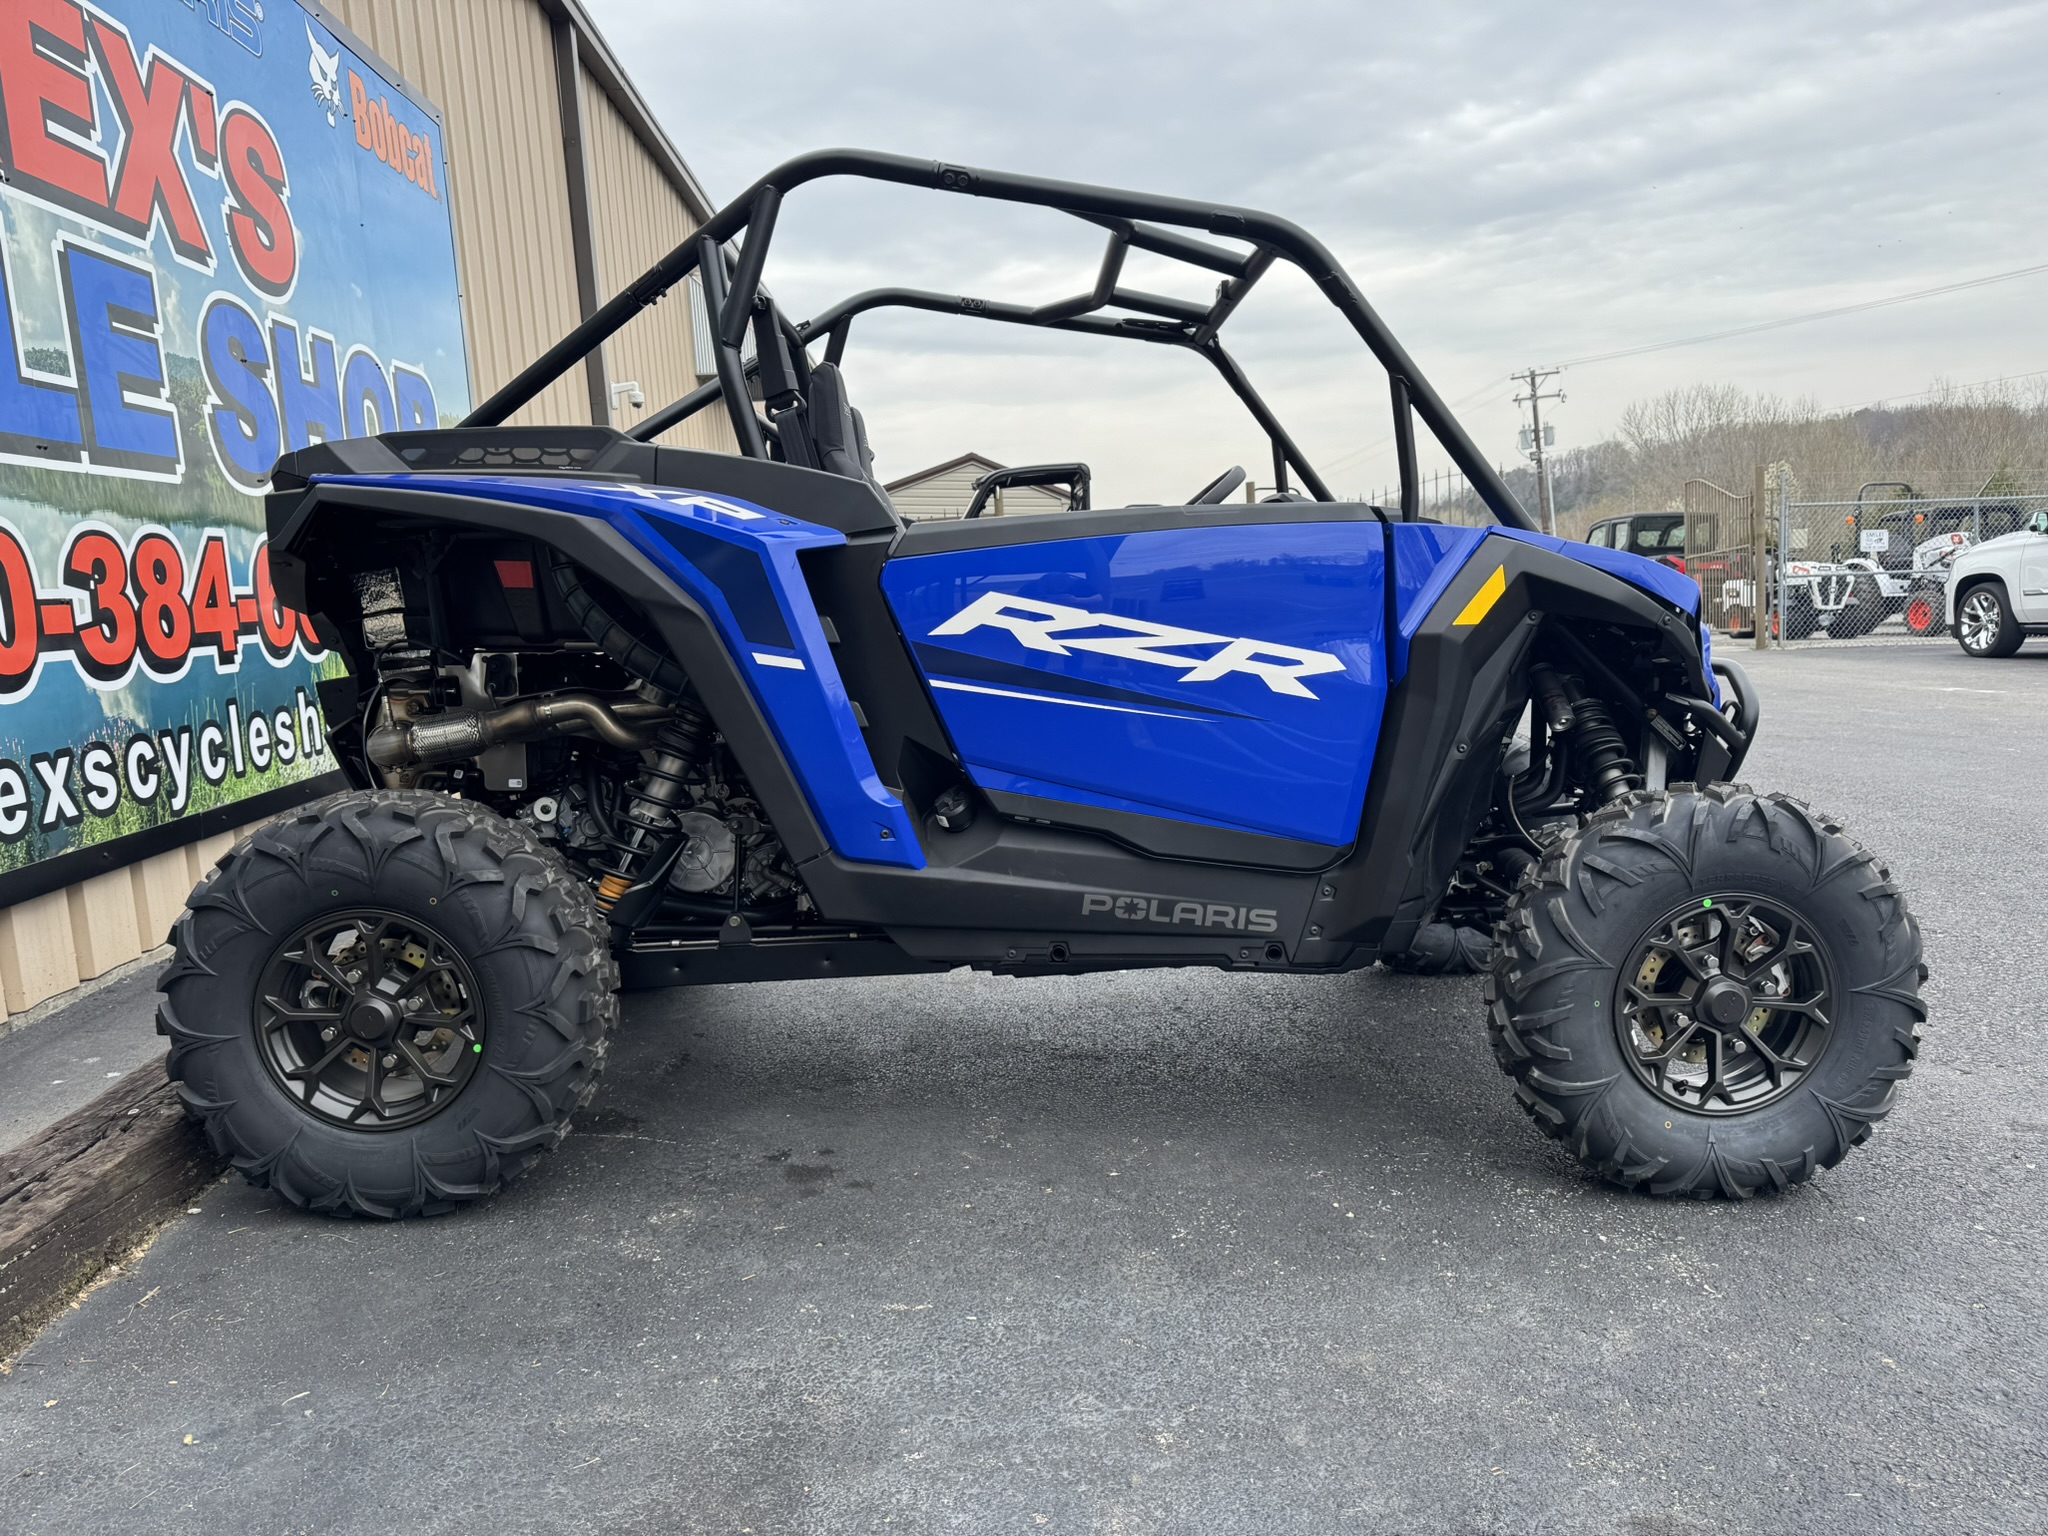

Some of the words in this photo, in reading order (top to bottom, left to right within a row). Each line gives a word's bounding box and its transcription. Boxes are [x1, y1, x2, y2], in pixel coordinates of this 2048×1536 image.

[348, 68, 438, 200] Bobcat
[928, 591, 1347, 700] RZR
[1082, 893, 1278, 933] POLARIS
